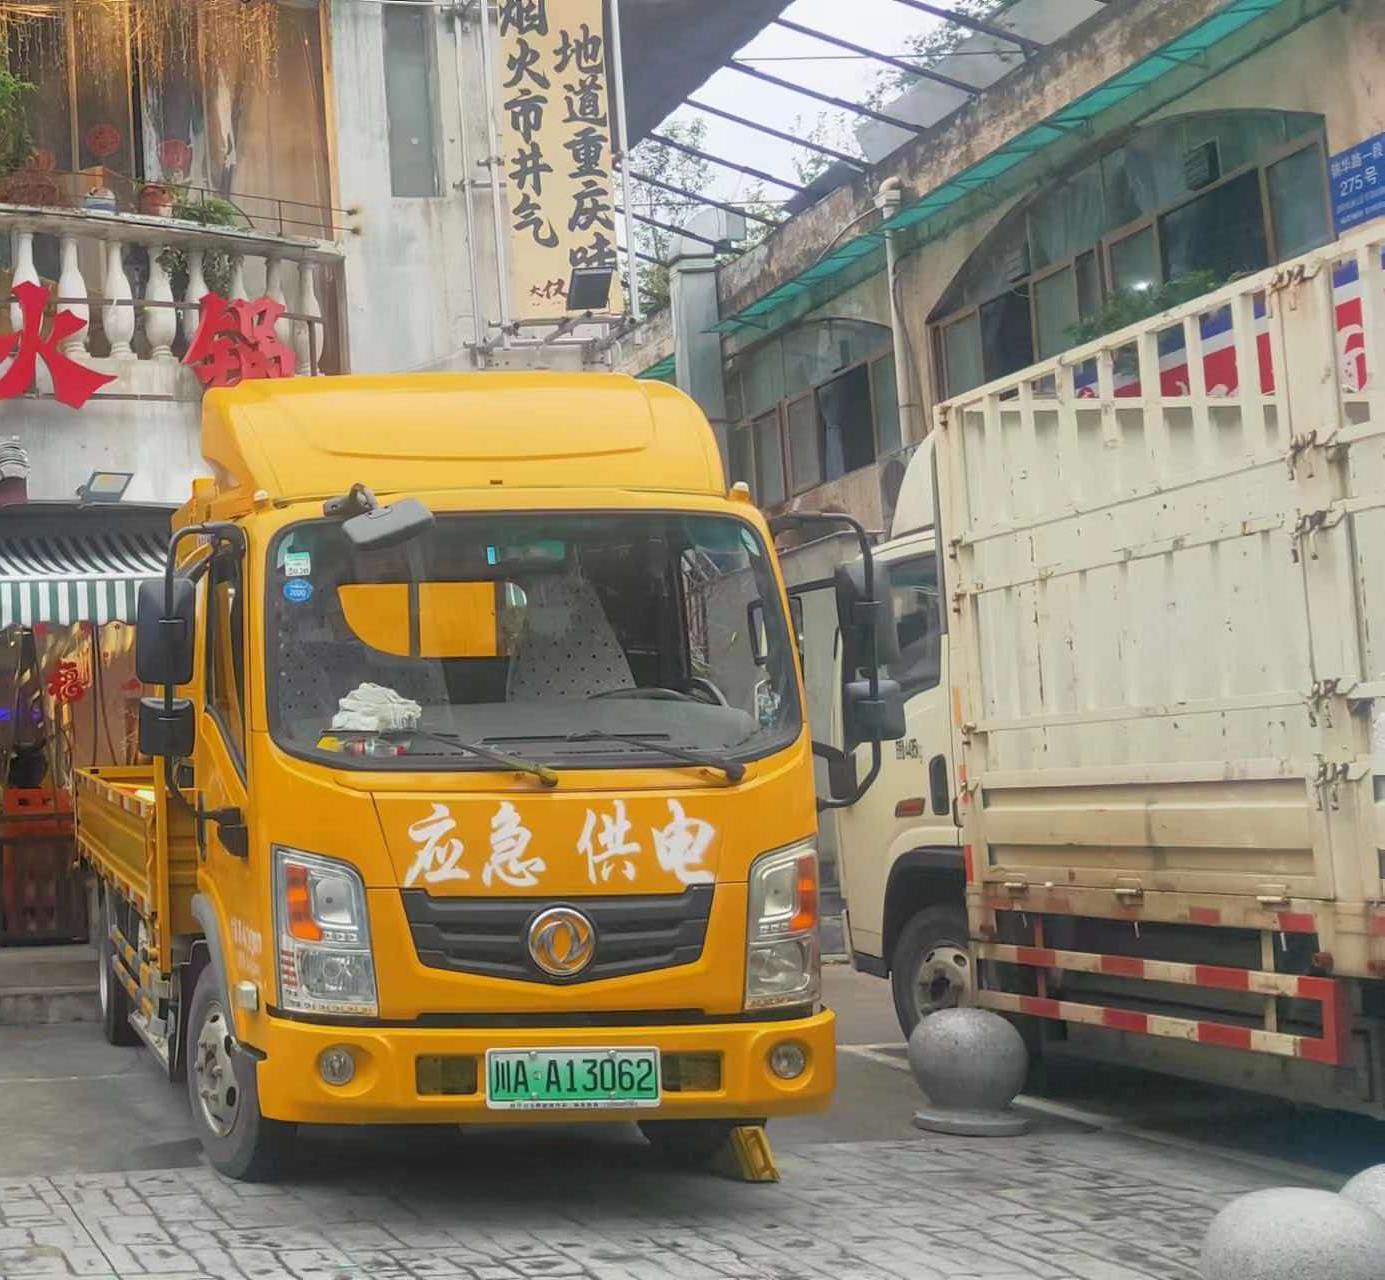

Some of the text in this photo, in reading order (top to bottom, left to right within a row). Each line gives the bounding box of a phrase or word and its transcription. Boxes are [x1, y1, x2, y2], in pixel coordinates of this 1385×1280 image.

[499, 0, 559, 249] 烟火市井气
[1340, 166, 1378, 197] 275号
[402, 798, 717, 888] 应急 供电
